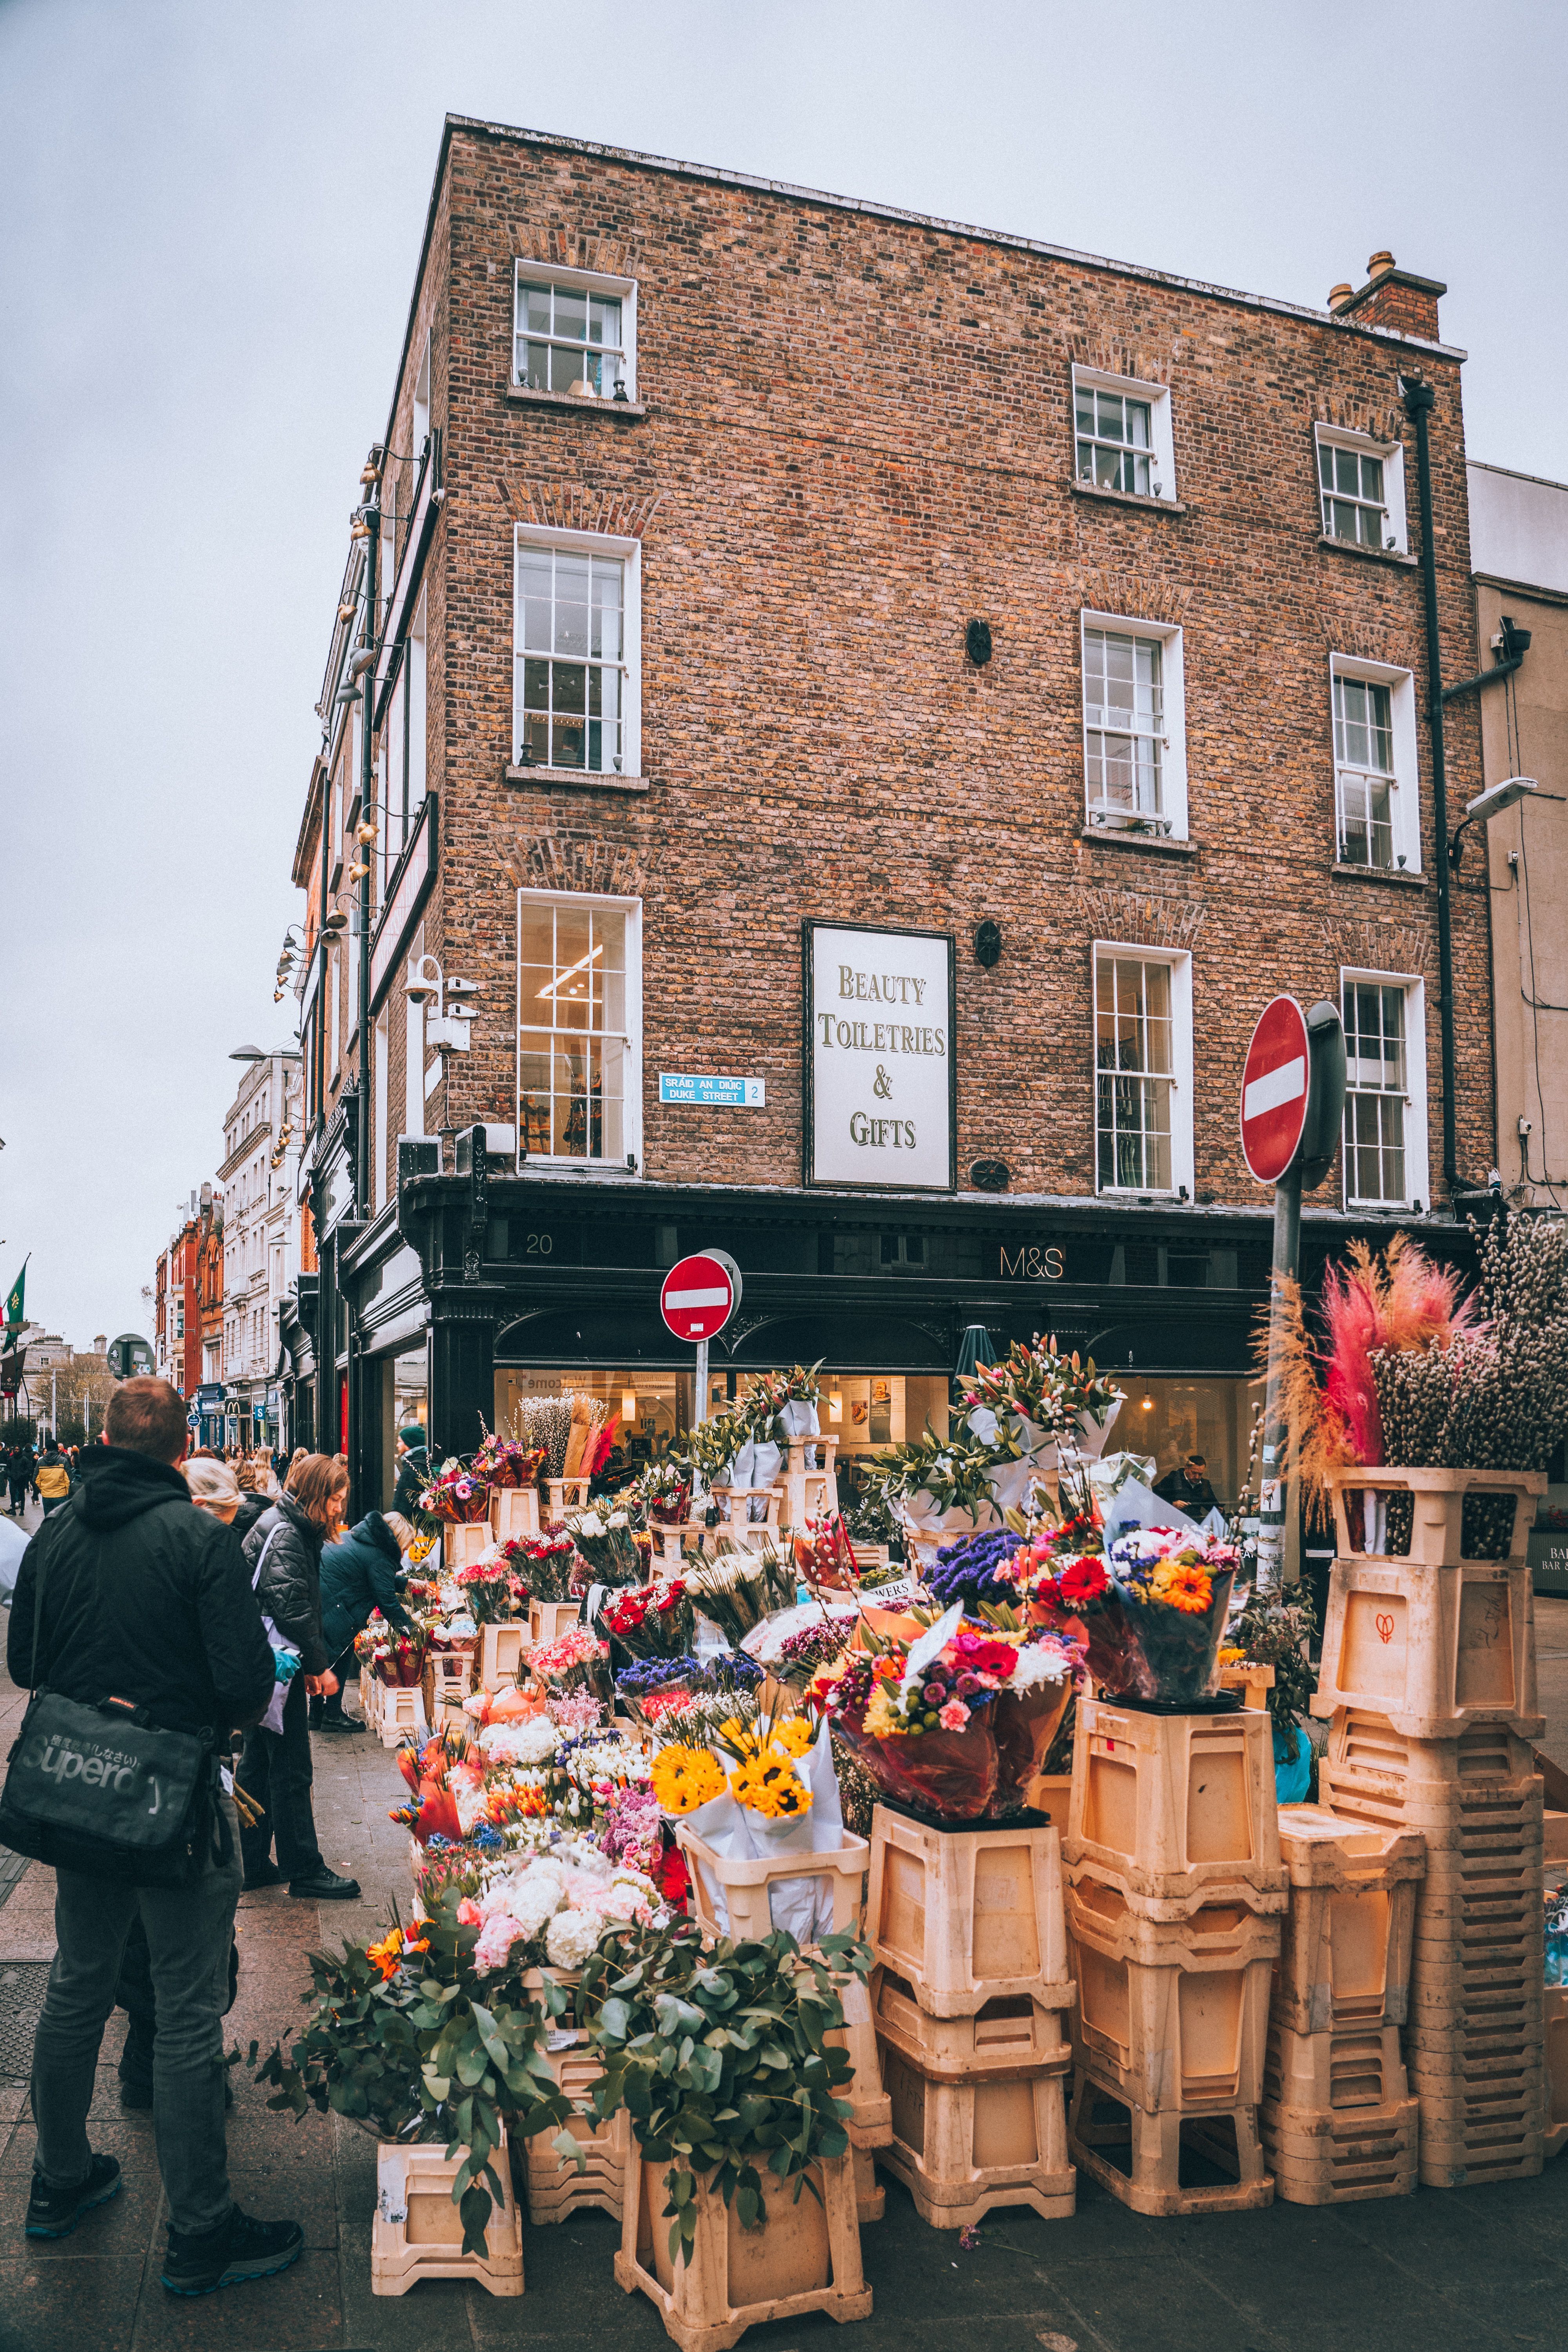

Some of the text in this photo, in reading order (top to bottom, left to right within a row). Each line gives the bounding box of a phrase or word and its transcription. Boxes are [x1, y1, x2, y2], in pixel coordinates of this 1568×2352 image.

[838, 965, 926, 1005] BEAUTY
[818, 1013, 946, 1056] TOILETRIES
[665, 1077, 742, 1091] SRÁID AN DIÚIC
[751, 1086, 758, 1098] 2
[873, 1064, 893, 1100] &
[670, 1090, 738, 1102] DUKE STREET
[850, 1112, 916, 1149] GIFTS
[526, 1234, 552, 1254] 20
[1000, 1247, 1063, 1278] M&S
[1542, 1561, 1560, 1570] BAR
[875, 1583, 909, 1597] WERS
